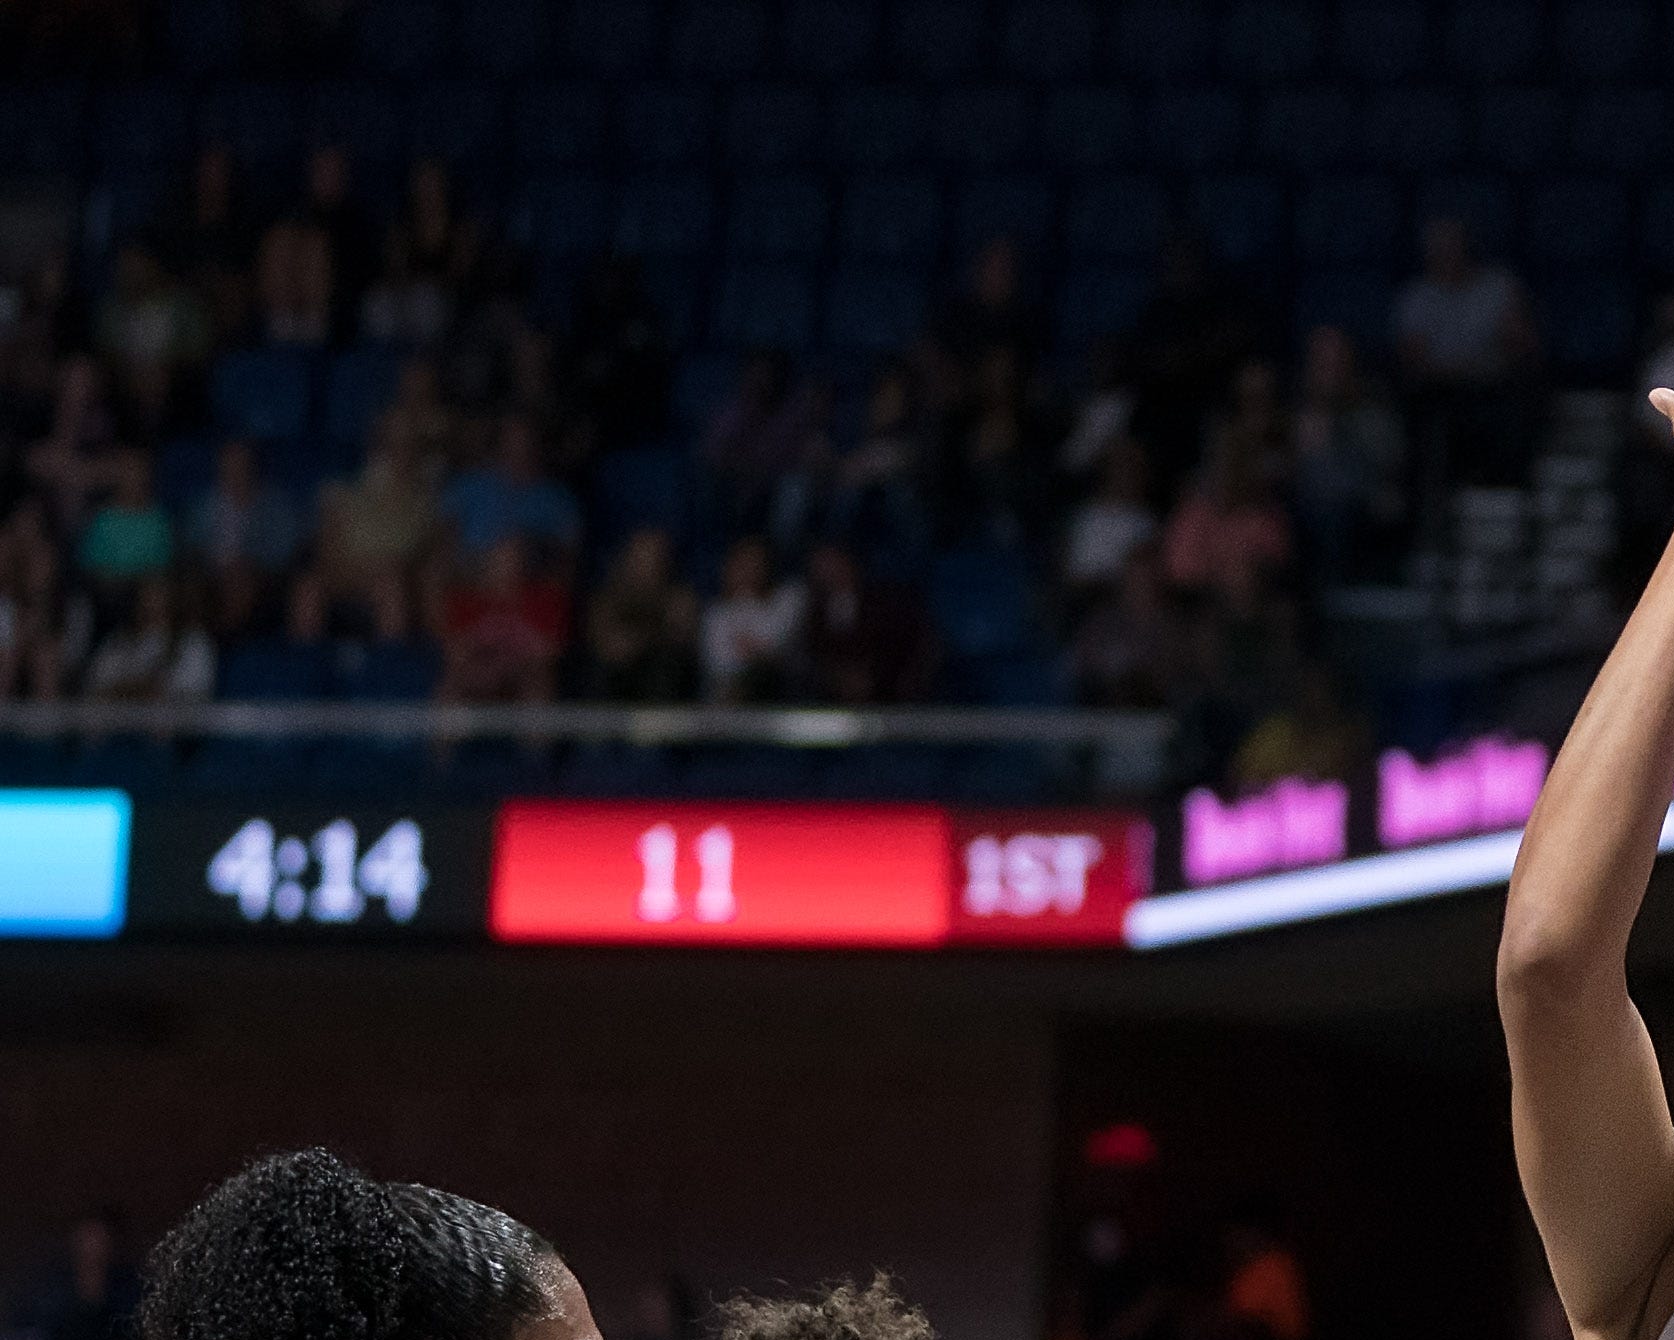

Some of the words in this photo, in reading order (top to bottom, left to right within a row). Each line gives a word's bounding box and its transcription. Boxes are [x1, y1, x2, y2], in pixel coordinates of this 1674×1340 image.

[206, 817, 428, 923] 4:14
[634, 821, 738, 923] 11
[965, 833, 1102, 916] 1ST
